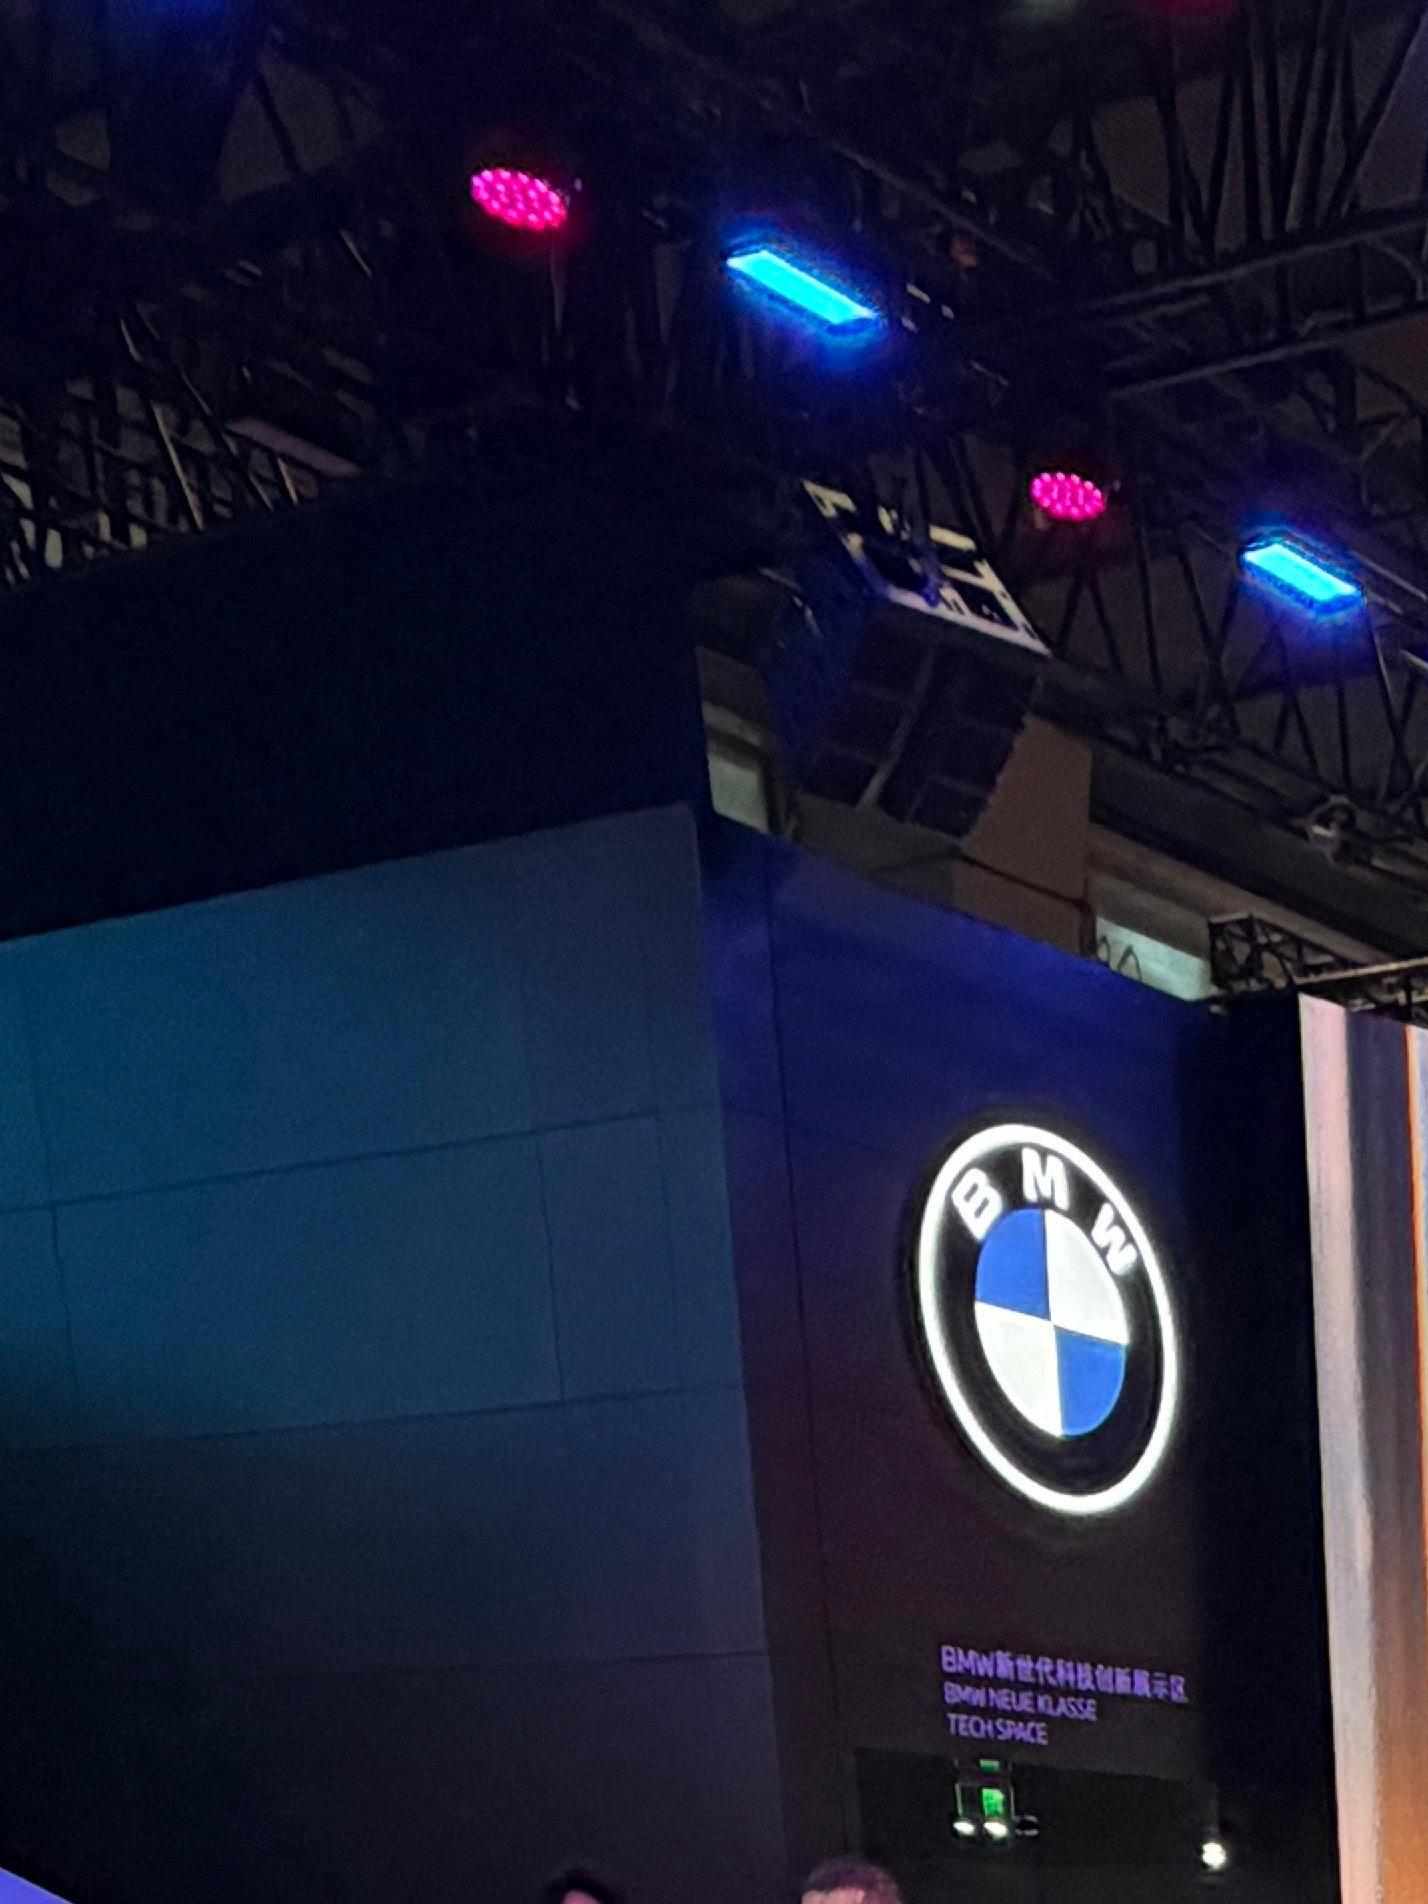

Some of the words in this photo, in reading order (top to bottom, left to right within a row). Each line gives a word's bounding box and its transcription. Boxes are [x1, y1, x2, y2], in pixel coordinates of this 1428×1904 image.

[952, 1146, 1139, 1275] BMW
[943, 1681, 986, 1708] BMW
[988, 1687, 1035, 1713] NEUE
[1037, 1693, 1097, 1722] KLASSE
[947, 1712, 994, 1739] TECH
[996, 1717, 1048, 1746] SPACE
